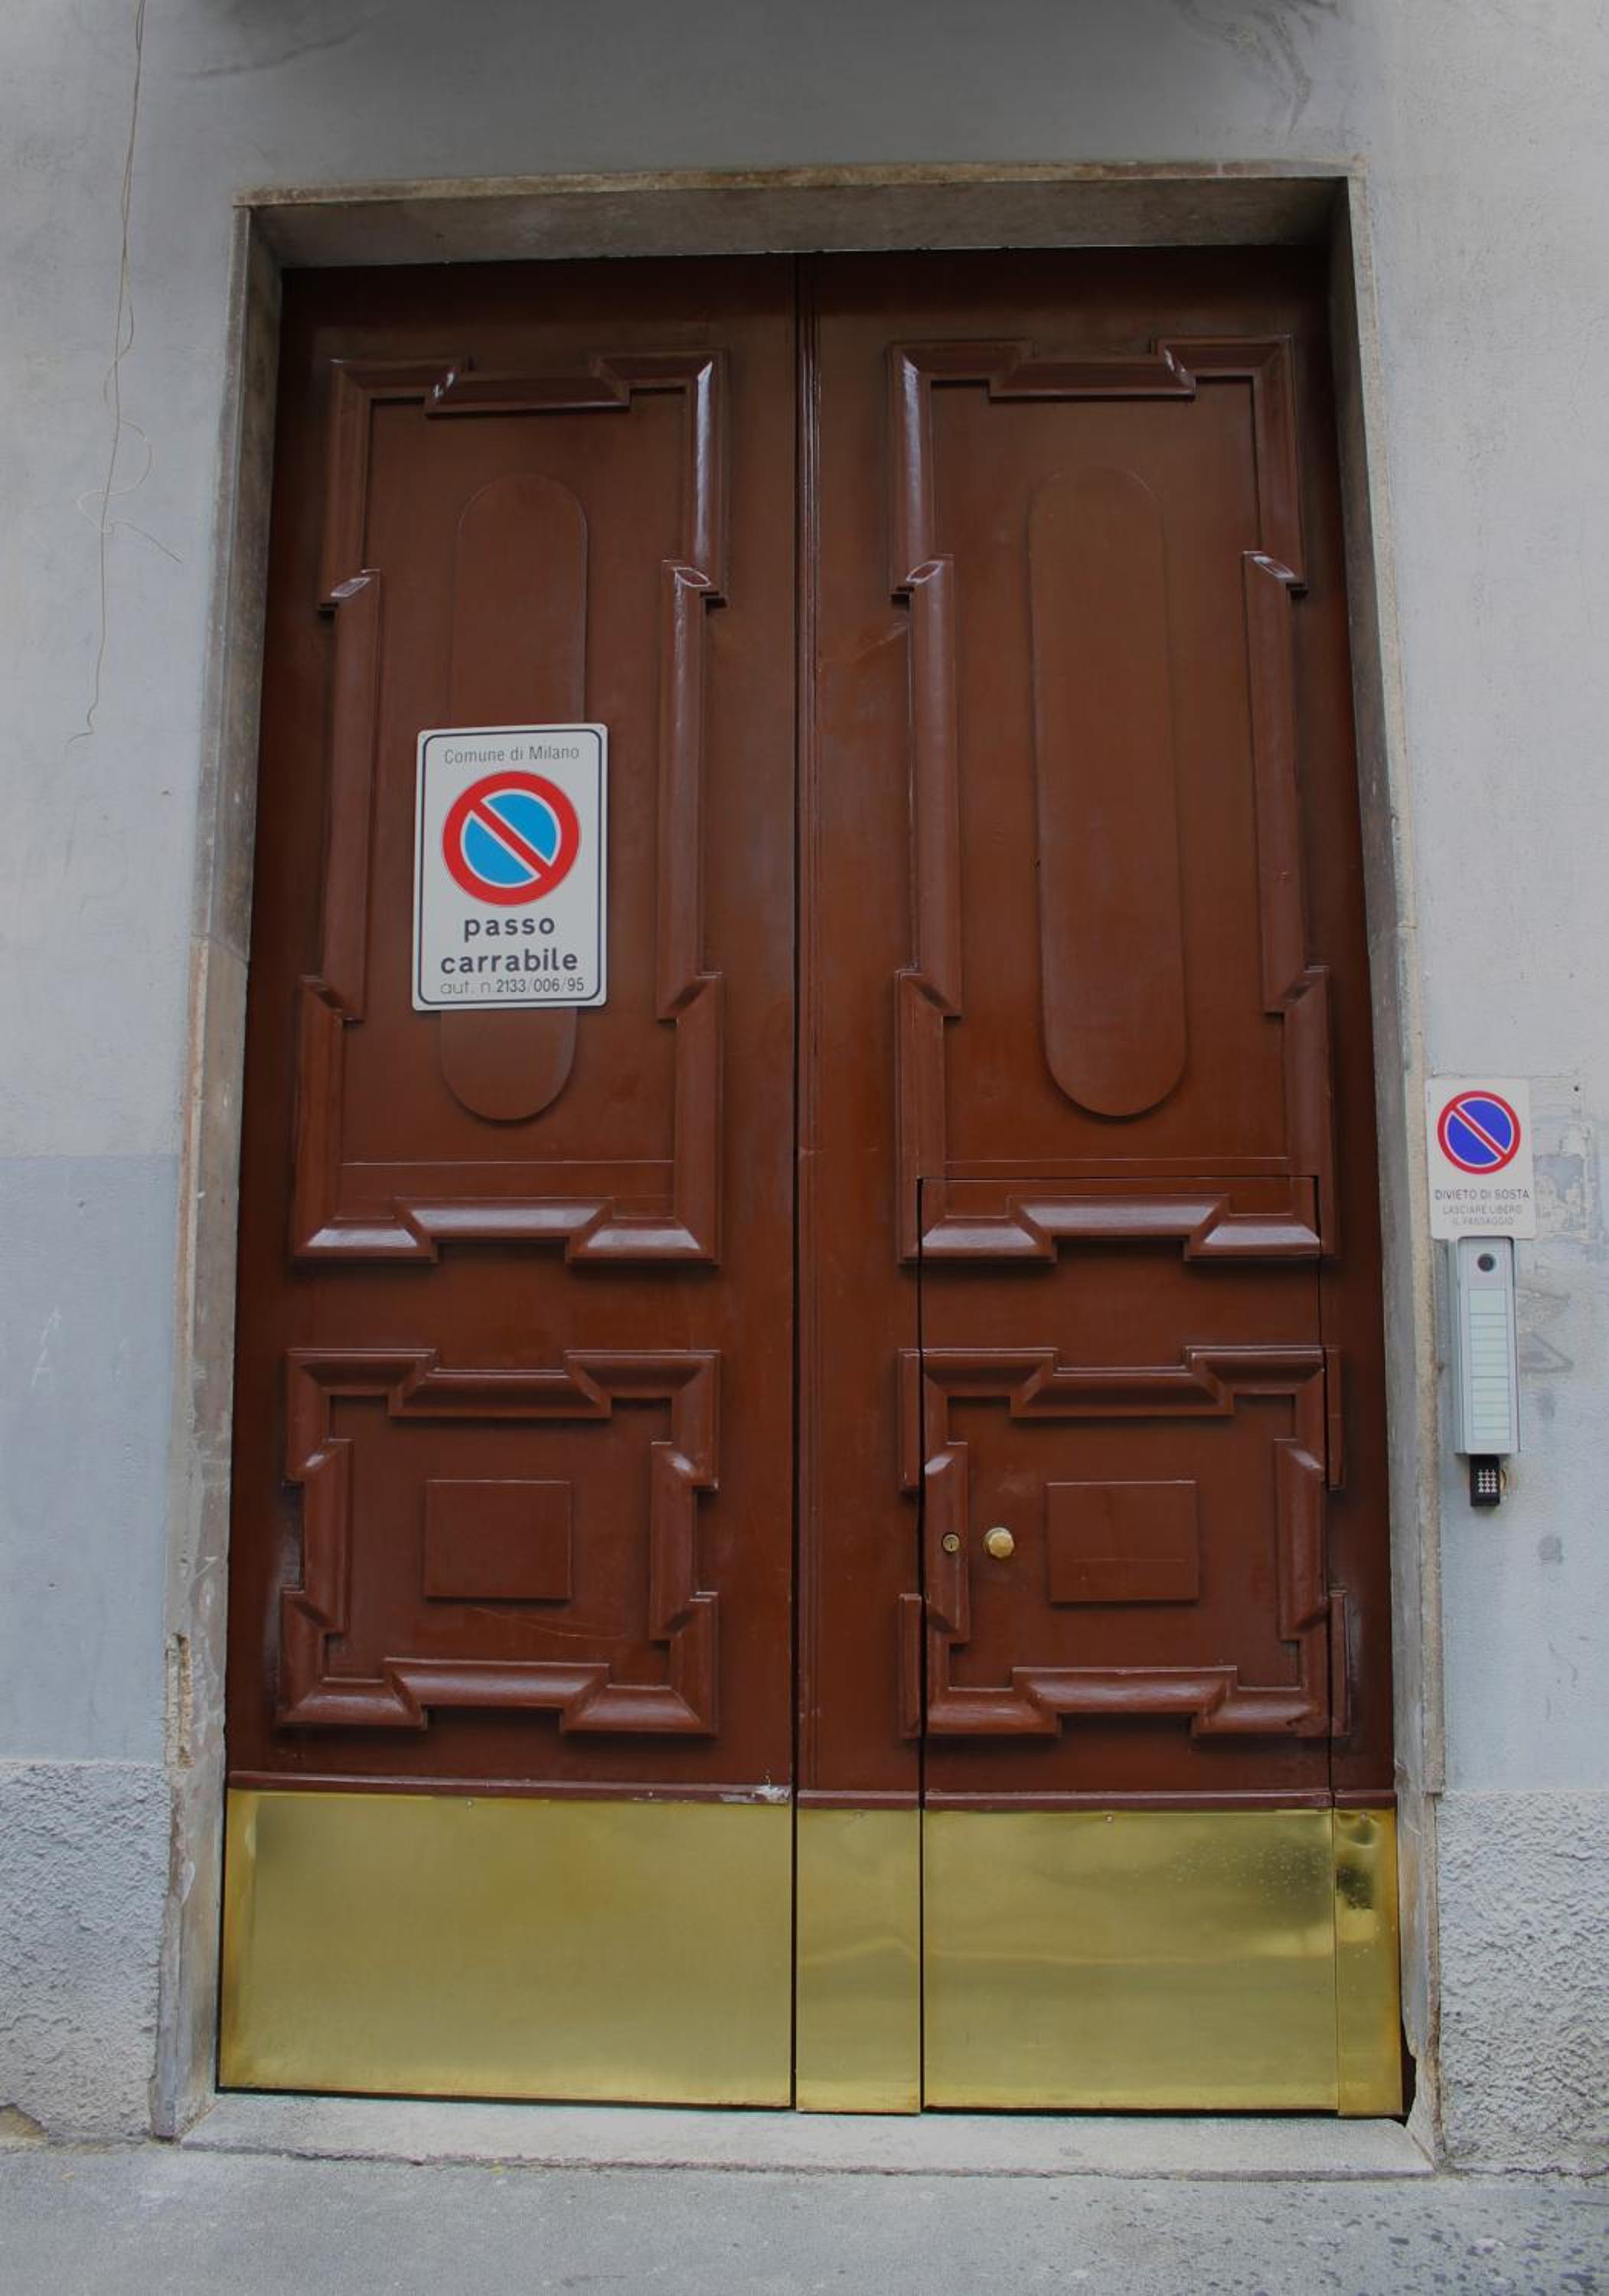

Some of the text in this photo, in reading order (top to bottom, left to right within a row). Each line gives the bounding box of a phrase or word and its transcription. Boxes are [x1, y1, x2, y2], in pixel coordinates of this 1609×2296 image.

[444, 745, 579, 764] Comune di Milano
[464, 918, 555, 943] passo
[441, 947, 578, 974] carrabile
[1434, 1189, 1529, 1201] DIVIETO DI SOSTA
